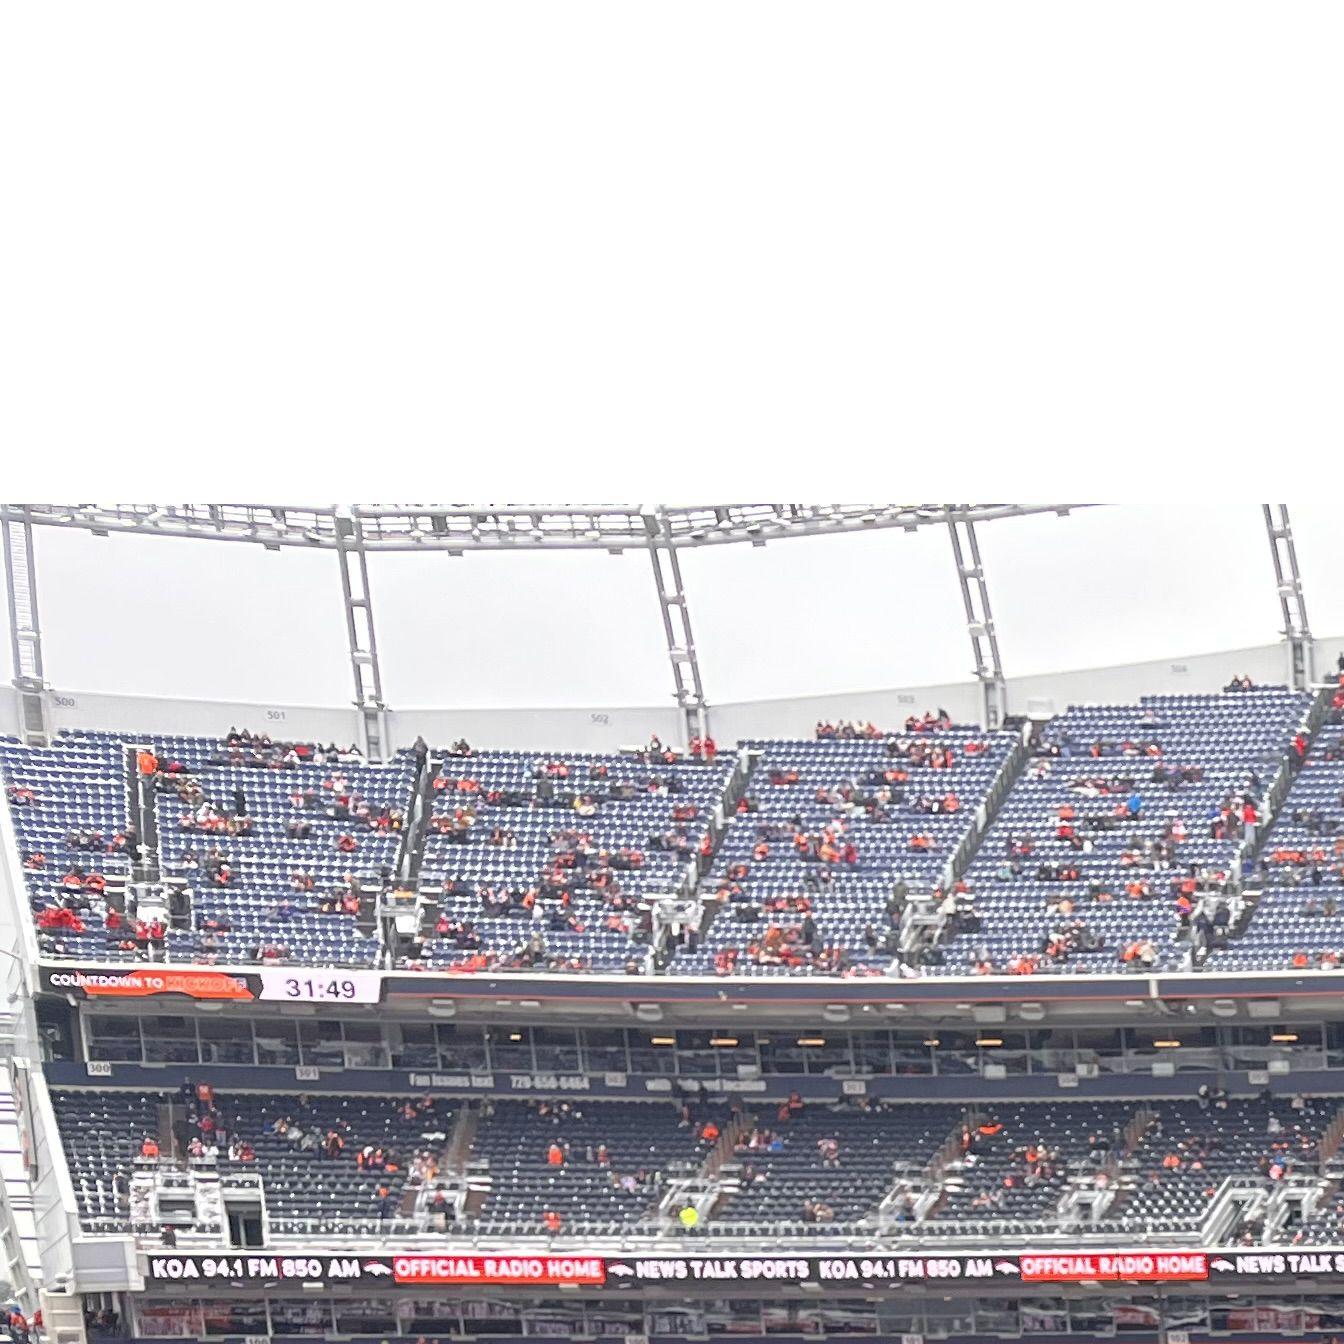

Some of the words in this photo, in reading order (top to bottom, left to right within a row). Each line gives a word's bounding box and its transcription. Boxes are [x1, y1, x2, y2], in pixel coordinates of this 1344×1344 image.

[55, 696, 75, 707] 500
[266, 710, 286, 720] 501
[49, 973, 142, 988] COUNTDOWN
[144, 976, 164, 989] TO
[285, 979, 356, 1000] 31:49
[88, 1063, 110, 1073] 300
[152, 1259, 199, 1278] KOA
[201, 1259, 242, 1277] 94.1
[248, 1259, 278, 1277] FM
[281, 1259, 322, 1277] 850
[327, 1259, 360, 1277] AM
[395, 1260, 480, 1276] OFFICIAL
[484, 1260, 543, 1277] RADIO
[547, 1261, 602, 1277] HOME
[636, 1261, 687, 1278] NEWS
[690, 1261, 737, 1278] TALK
[740, 1261, 809, 1278] SPORTS
[819, 1261, 858, 1279] KOA
[861, 1260, 896, 1277] 94.1
[899, 1260, 923, 1277] FM
[927, 1260, 961, 1277] 850
[964, 1259, 993, 1276] AM
[1021, 1258, 1096, 1274] OFFICIAL
[1099, 1257, 1153, 1273] RADIO
[1157, 1256, 1205, 1273] HOME
[1236, 1255, 1285, 1273] NEWS
[1288, 1255, 1333, 1272] TALK
